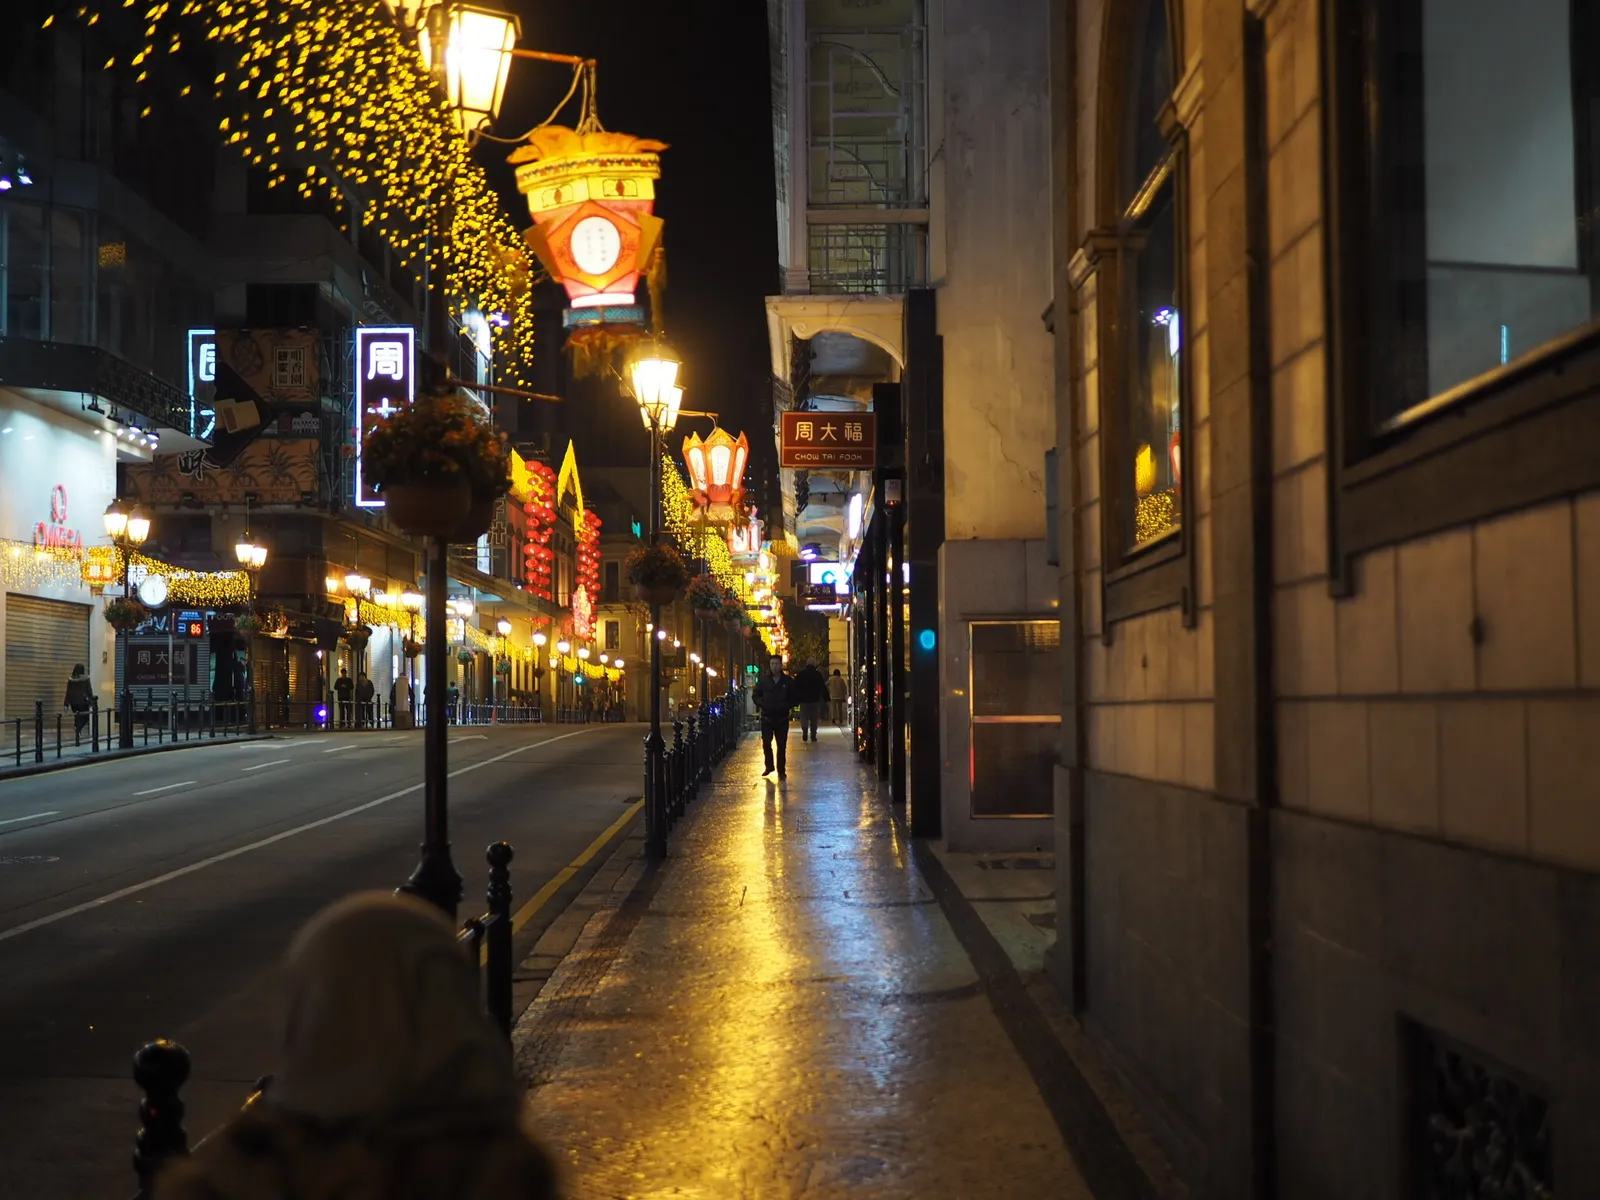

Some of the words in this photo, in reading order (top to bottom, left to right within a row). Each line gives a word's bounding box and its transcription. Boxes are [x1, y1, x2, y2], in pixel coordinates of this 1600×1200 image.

[795, 421, 863, 442] 周大福
[794, 453, 819, 461] CHOW
[822, 453, 836, 461] TAI
[840, 453, 863, 461] FOOK
[191, 623, 201, 634] 86
